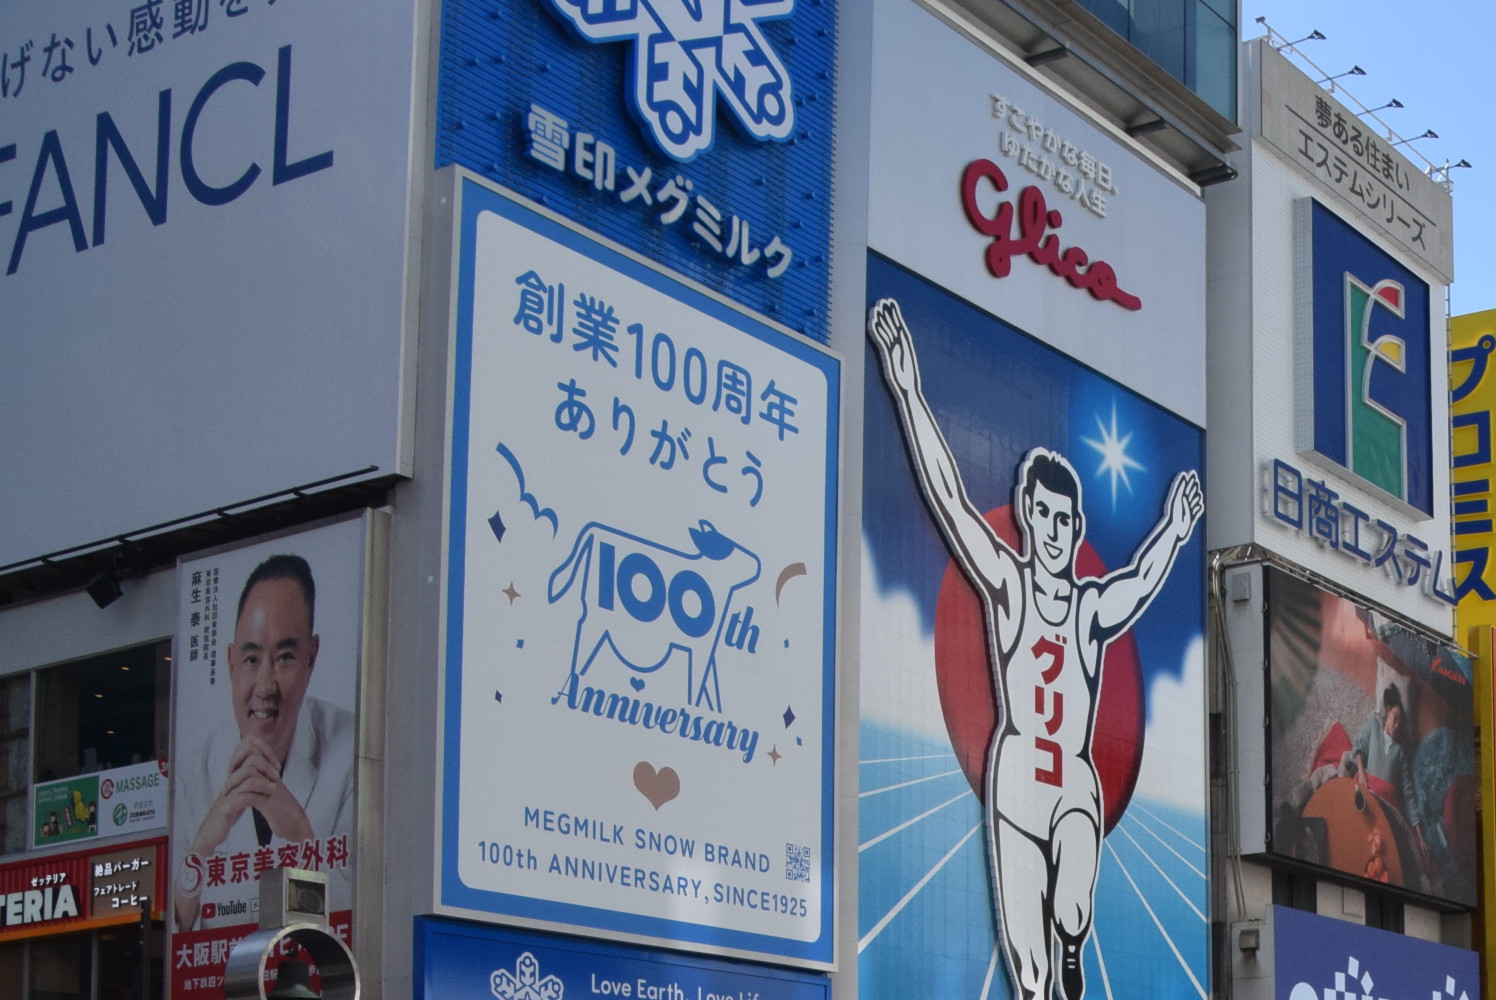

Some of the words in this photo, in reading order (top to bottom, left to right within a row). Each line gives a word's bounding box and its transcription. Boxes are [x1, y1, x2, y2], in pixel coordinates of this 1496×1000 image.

[991, 92, 1119, 197] すこやかな毎日、
[1000, 131, 1108, 219] ゆたかな人生
[1314, 95, 1411, 193] 夢ある住まい
[523, 102, 796, 282] 雪印メグミルク
[1298, 127, 1427, 251] エステムシリーズ
[961, 158, 1142, 311] Glico
[514, 268, 801, 443] 創業100周年
[553, 376, 768, 508] ありがとう
[1272, 457, 1459, 607] 日商エステム
[599, 541, 715, 638] 100
[725, 605, 760, 654] th
[551, 673, 759, 764] Anniversary
[1031, 633, 1067, 789] グリコ
[116, 773, 160, 793] MASSAGE
[31, 872, 66, 887] ゼッテリア
[94, 858, 149, 877] 絶品バーガー
[206, 835, 349, 888] 東京美容外科
[478, 840, 538, 872] 100th
[524, 806, 624, 846] MEGMILK
[634, 828, 695, 859] SNOW
[704, 842, 771, 874] BRAND
[94, 881, 138, 896] フェアトレード
[111, 894, 148, 908] コーヒー
[217, 902, 247, 917] YouTube
[591, 973, 632, 998] Love
